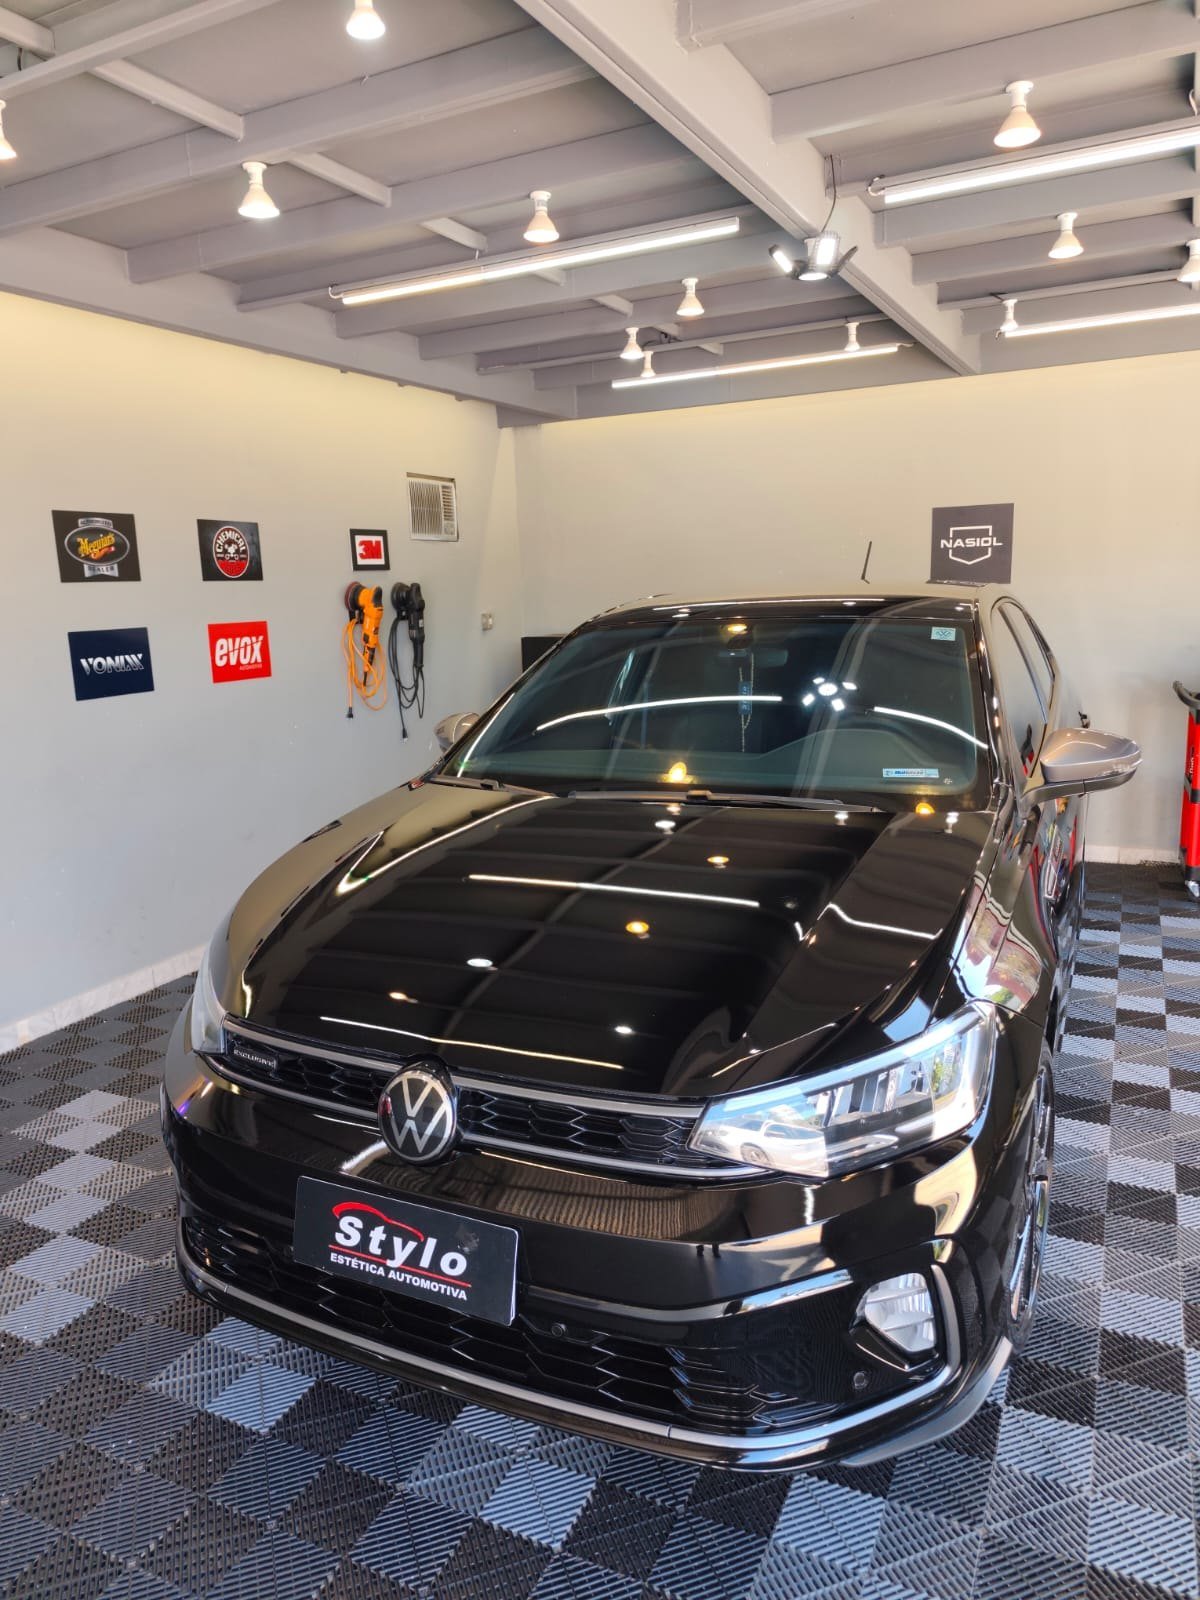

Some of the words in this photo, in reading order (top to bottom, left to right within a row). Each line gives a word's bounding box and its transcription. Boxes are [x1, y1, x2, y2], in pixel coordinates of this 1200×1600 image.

[216, 530, 246, 553] CHEMICAL
[358, 540, 382, 559] 3M
[940, 536, 1003, 549] NASIOL
[335, 1215, 467, 1277] Stylo
[330, 1252, 385, 1277] ESTÉTICA
[388, 1270, 467, 1301] AUTOMOTIVA
